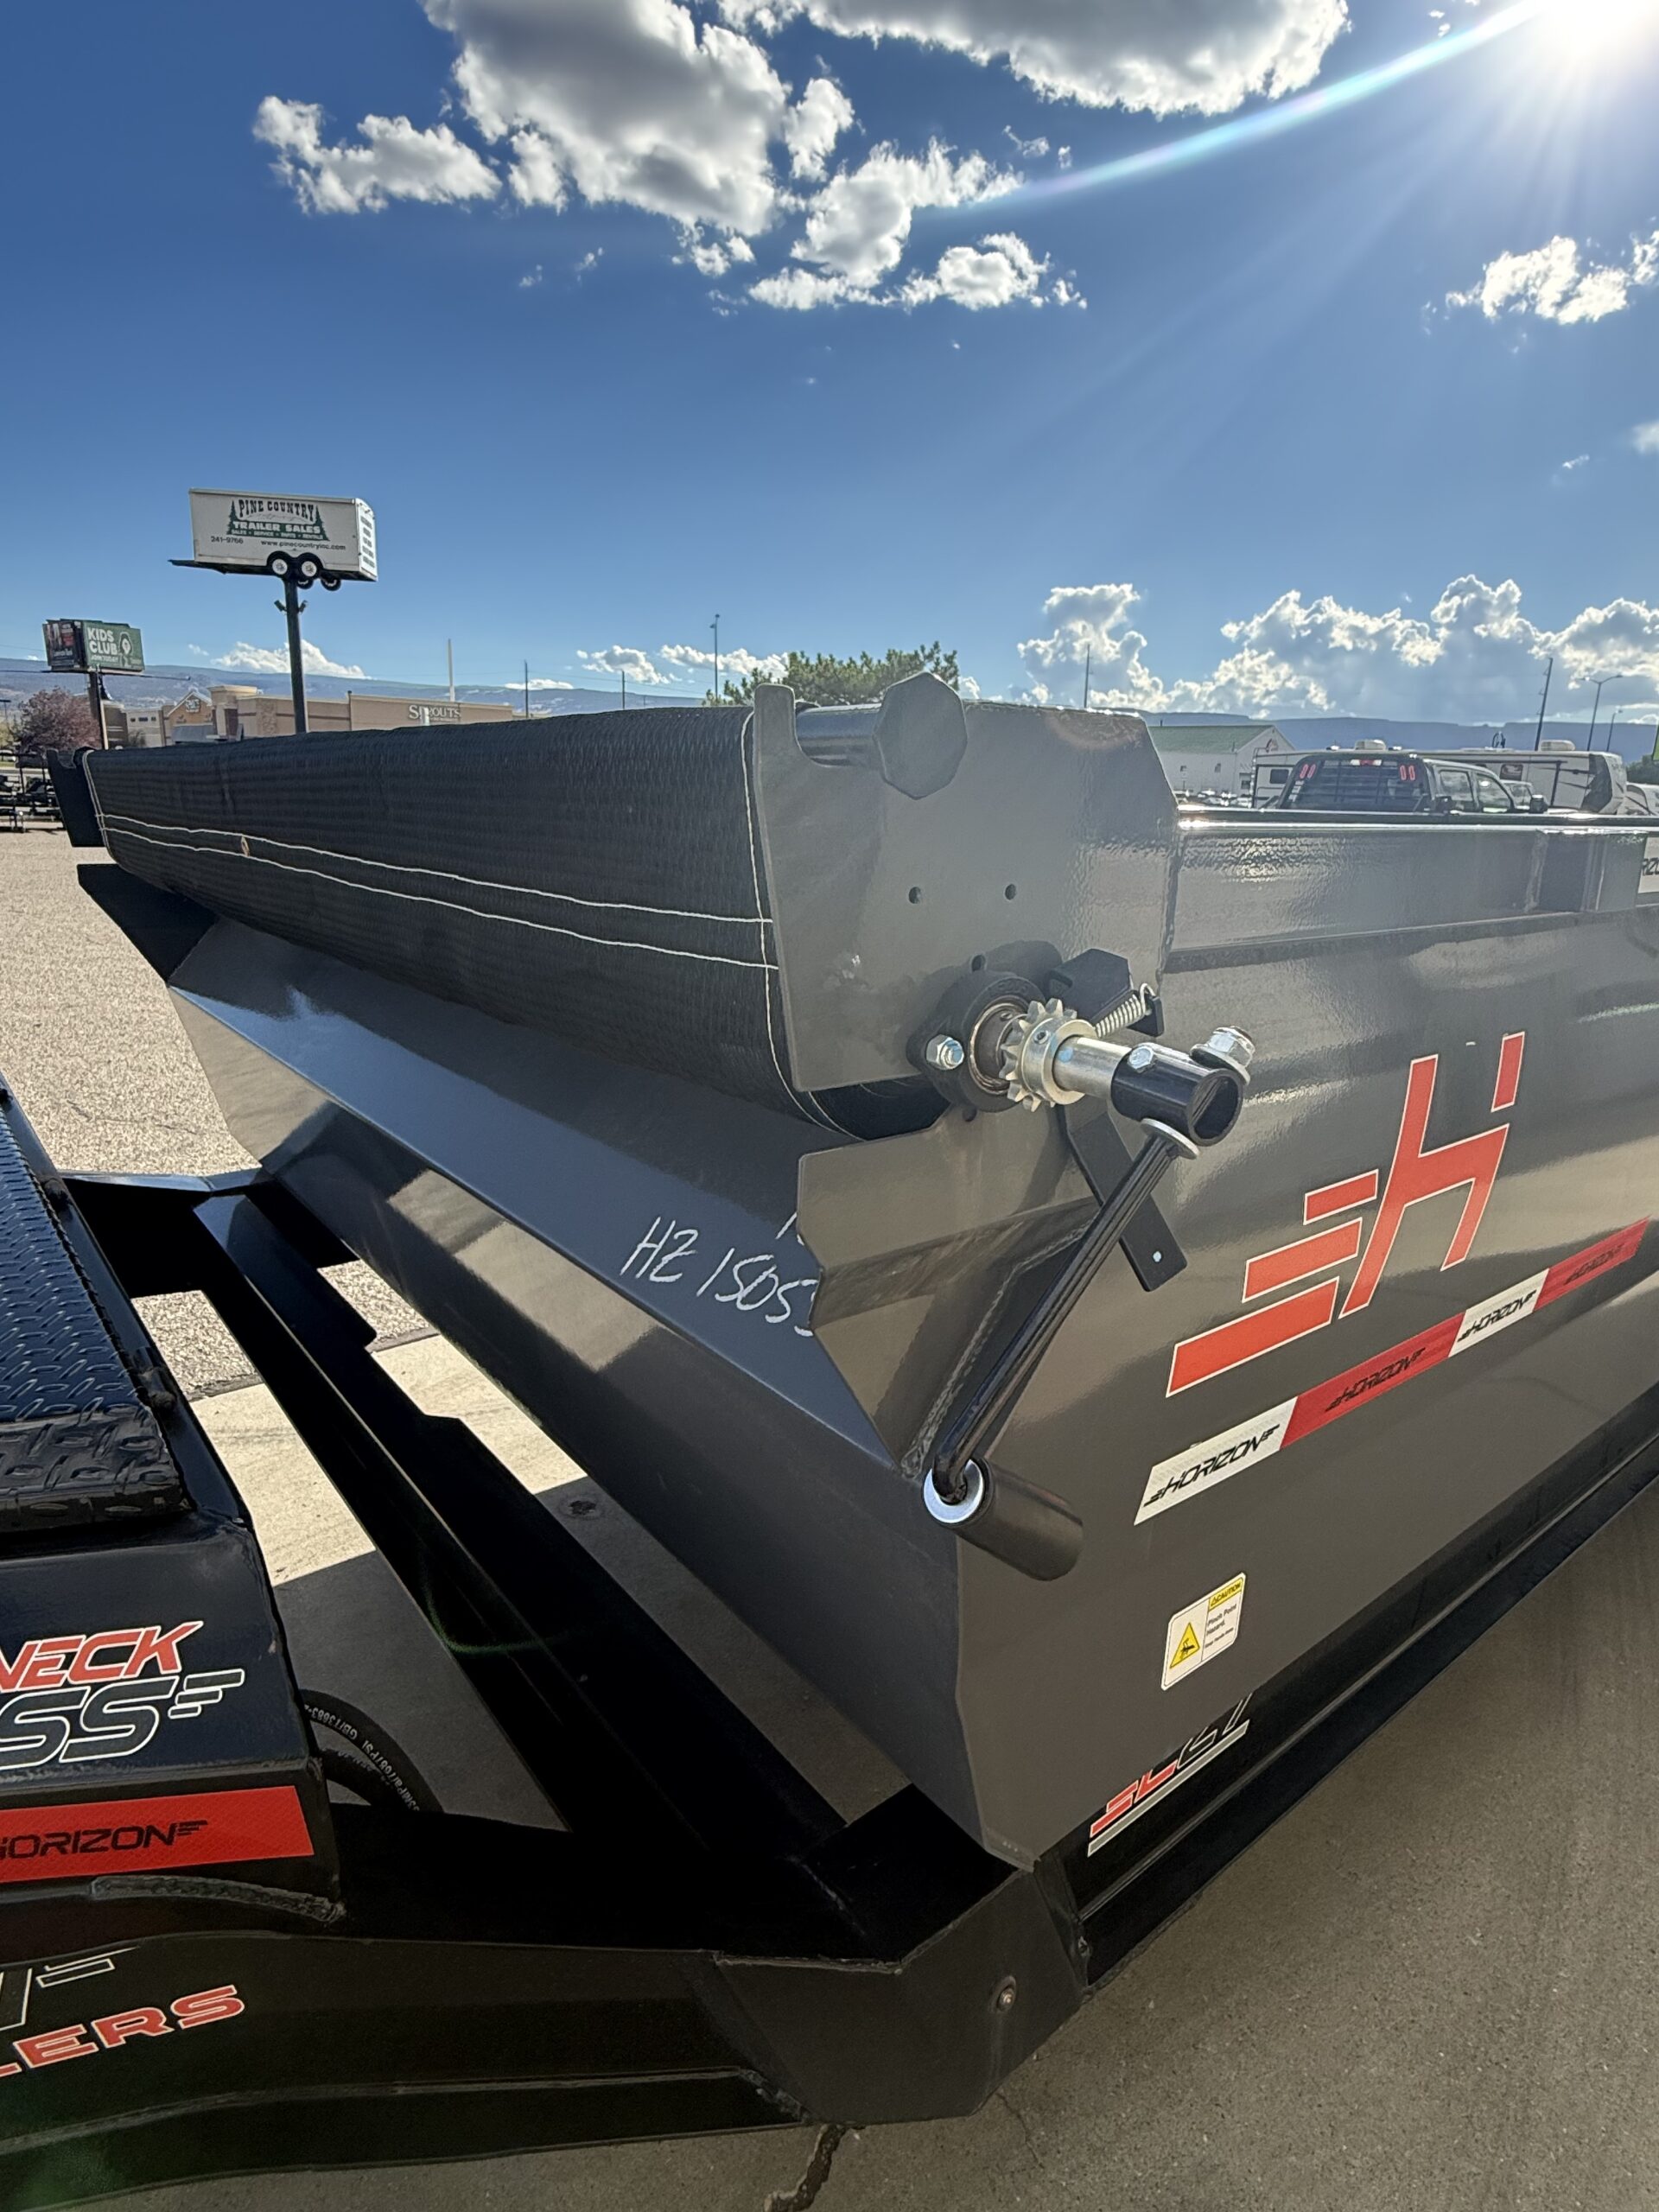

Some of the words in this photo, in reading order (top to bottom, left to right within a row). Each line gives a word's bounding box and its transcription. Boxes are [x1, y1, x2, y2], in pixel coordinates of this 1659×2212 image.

[238, 499, 264, 518] PINE
[267, 501, 314, 522] COUNTRY
[232, 521, 281, 531] TRAILER
[285, 524, 321, 534] SALES
[87, 626, 114, 642] KIDS
[89, 640, 118, 655] CLUB
[1463, 1294, 1531, 1338] HORIZON
[1332, 1351, 1420, 1407] HORIZON
[1152, 1427, 1273, 1503] HORIZON
